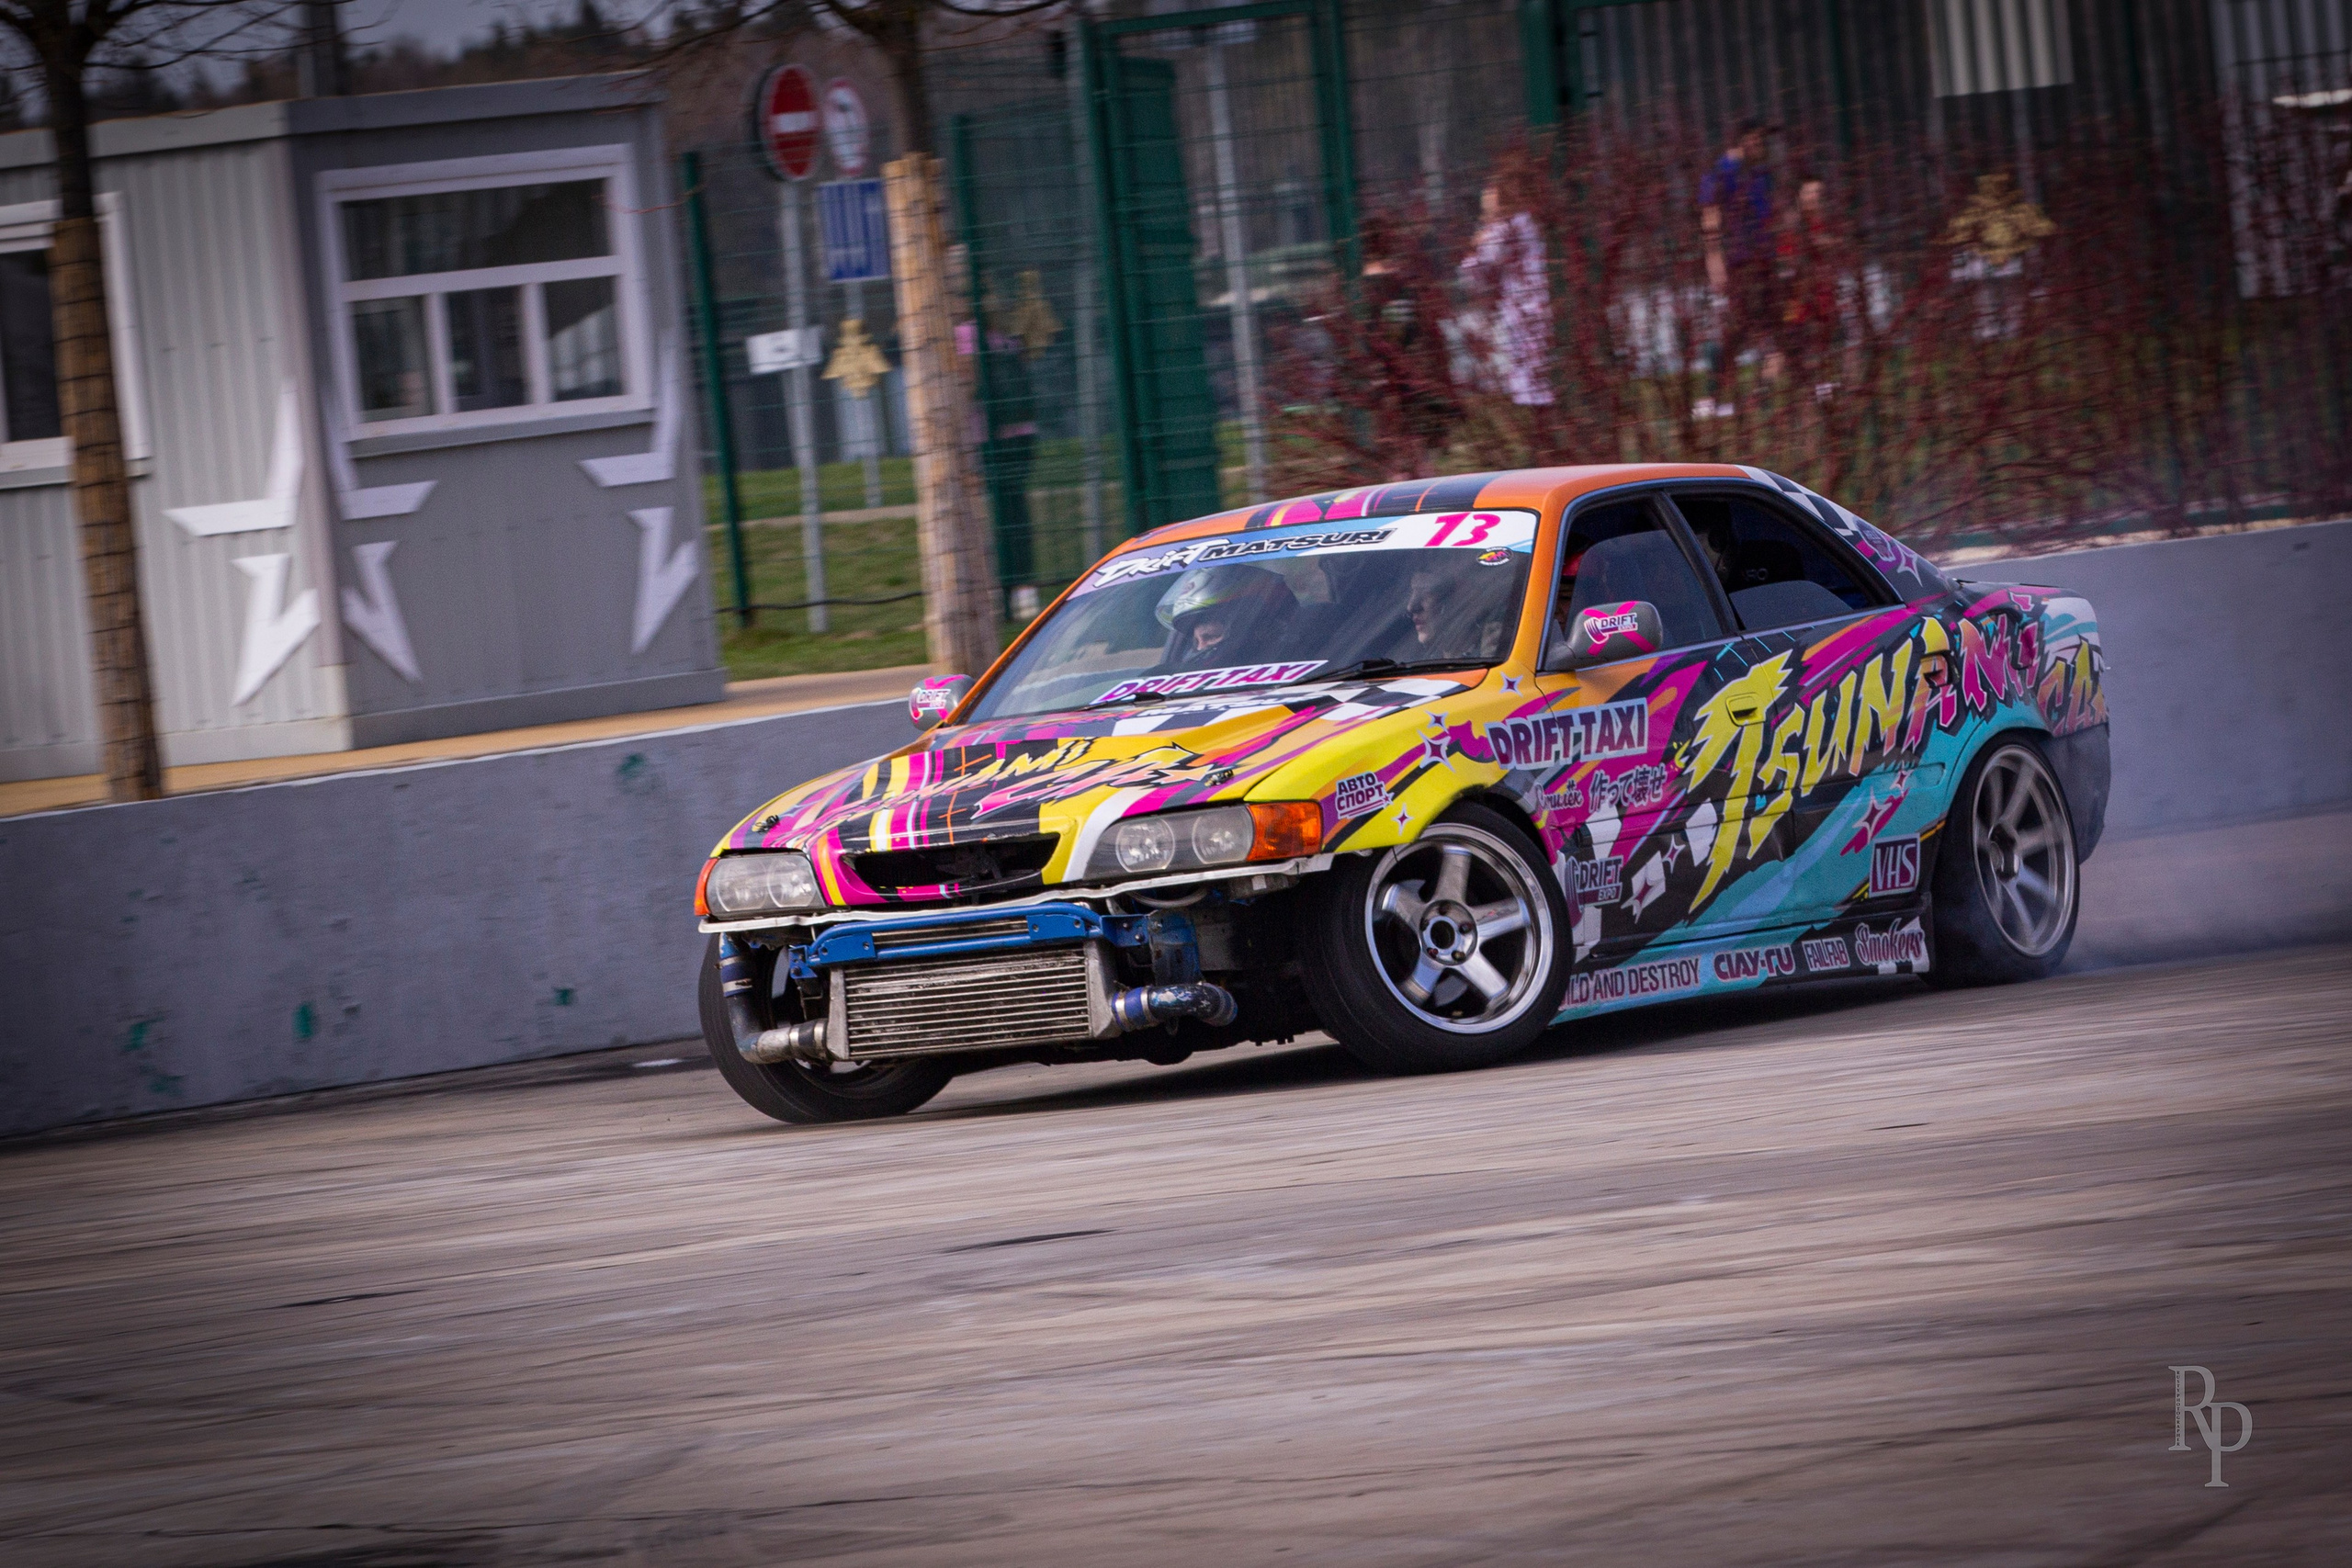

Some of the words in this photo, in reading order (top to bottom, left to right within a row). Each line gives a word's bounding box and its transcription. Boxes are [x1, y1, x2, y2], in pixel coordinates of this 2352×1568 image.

[1198, 528, 1398, 562] MATSURI
[1423, 512, 1501, 548] 13
[1601, 614, 1635, 628] DRIFT
[1095, 671, 1220, 703] DRIFT
[1209, 661, 1323, 687] TAXI
[1487, 714, 1575, 768] DRIFT
[1578, 703, 1647, 759] TAXI
[1337, 784, 1385, 811] СПОРТ
[1338, 773, 1376, 795] АВТО
[1579, 858, 1623, 890] DRIFT
[1874, 843, 1917, 892] VHS
[1855, 919, 1925, 965] Smokers
[1562, 976, 1589, 1005] ILD
[1592, 970, 1624, 1000] AND
[1628, 958, 1700, 995] DESTROY
